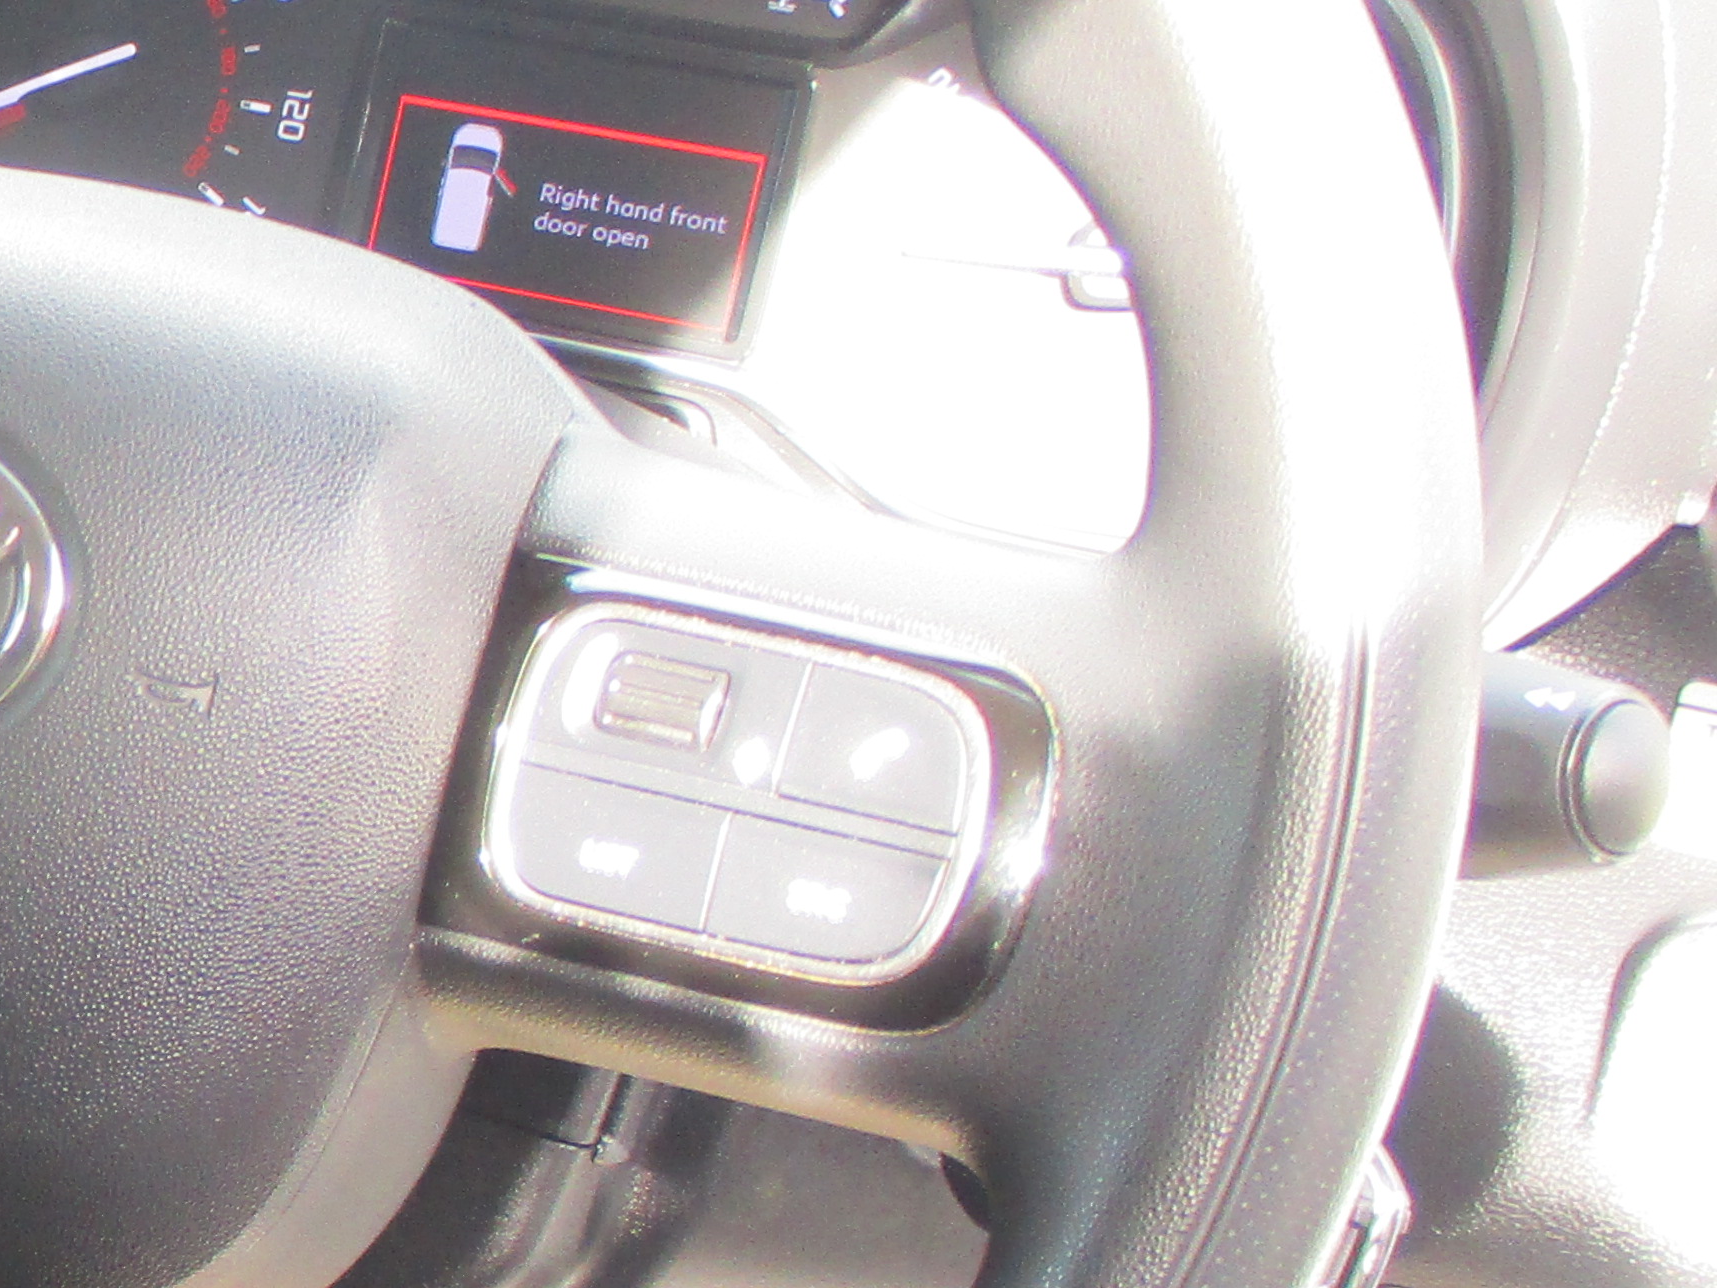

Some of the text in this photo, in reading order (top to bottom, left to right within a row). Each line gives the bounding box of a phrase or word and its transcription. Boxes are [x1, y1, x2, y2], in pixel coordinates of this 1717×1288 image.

[276, 89, 314, 142] 120
[533, 212, 650, 250] door open
[539, 182, 729, 235] Right hand front
